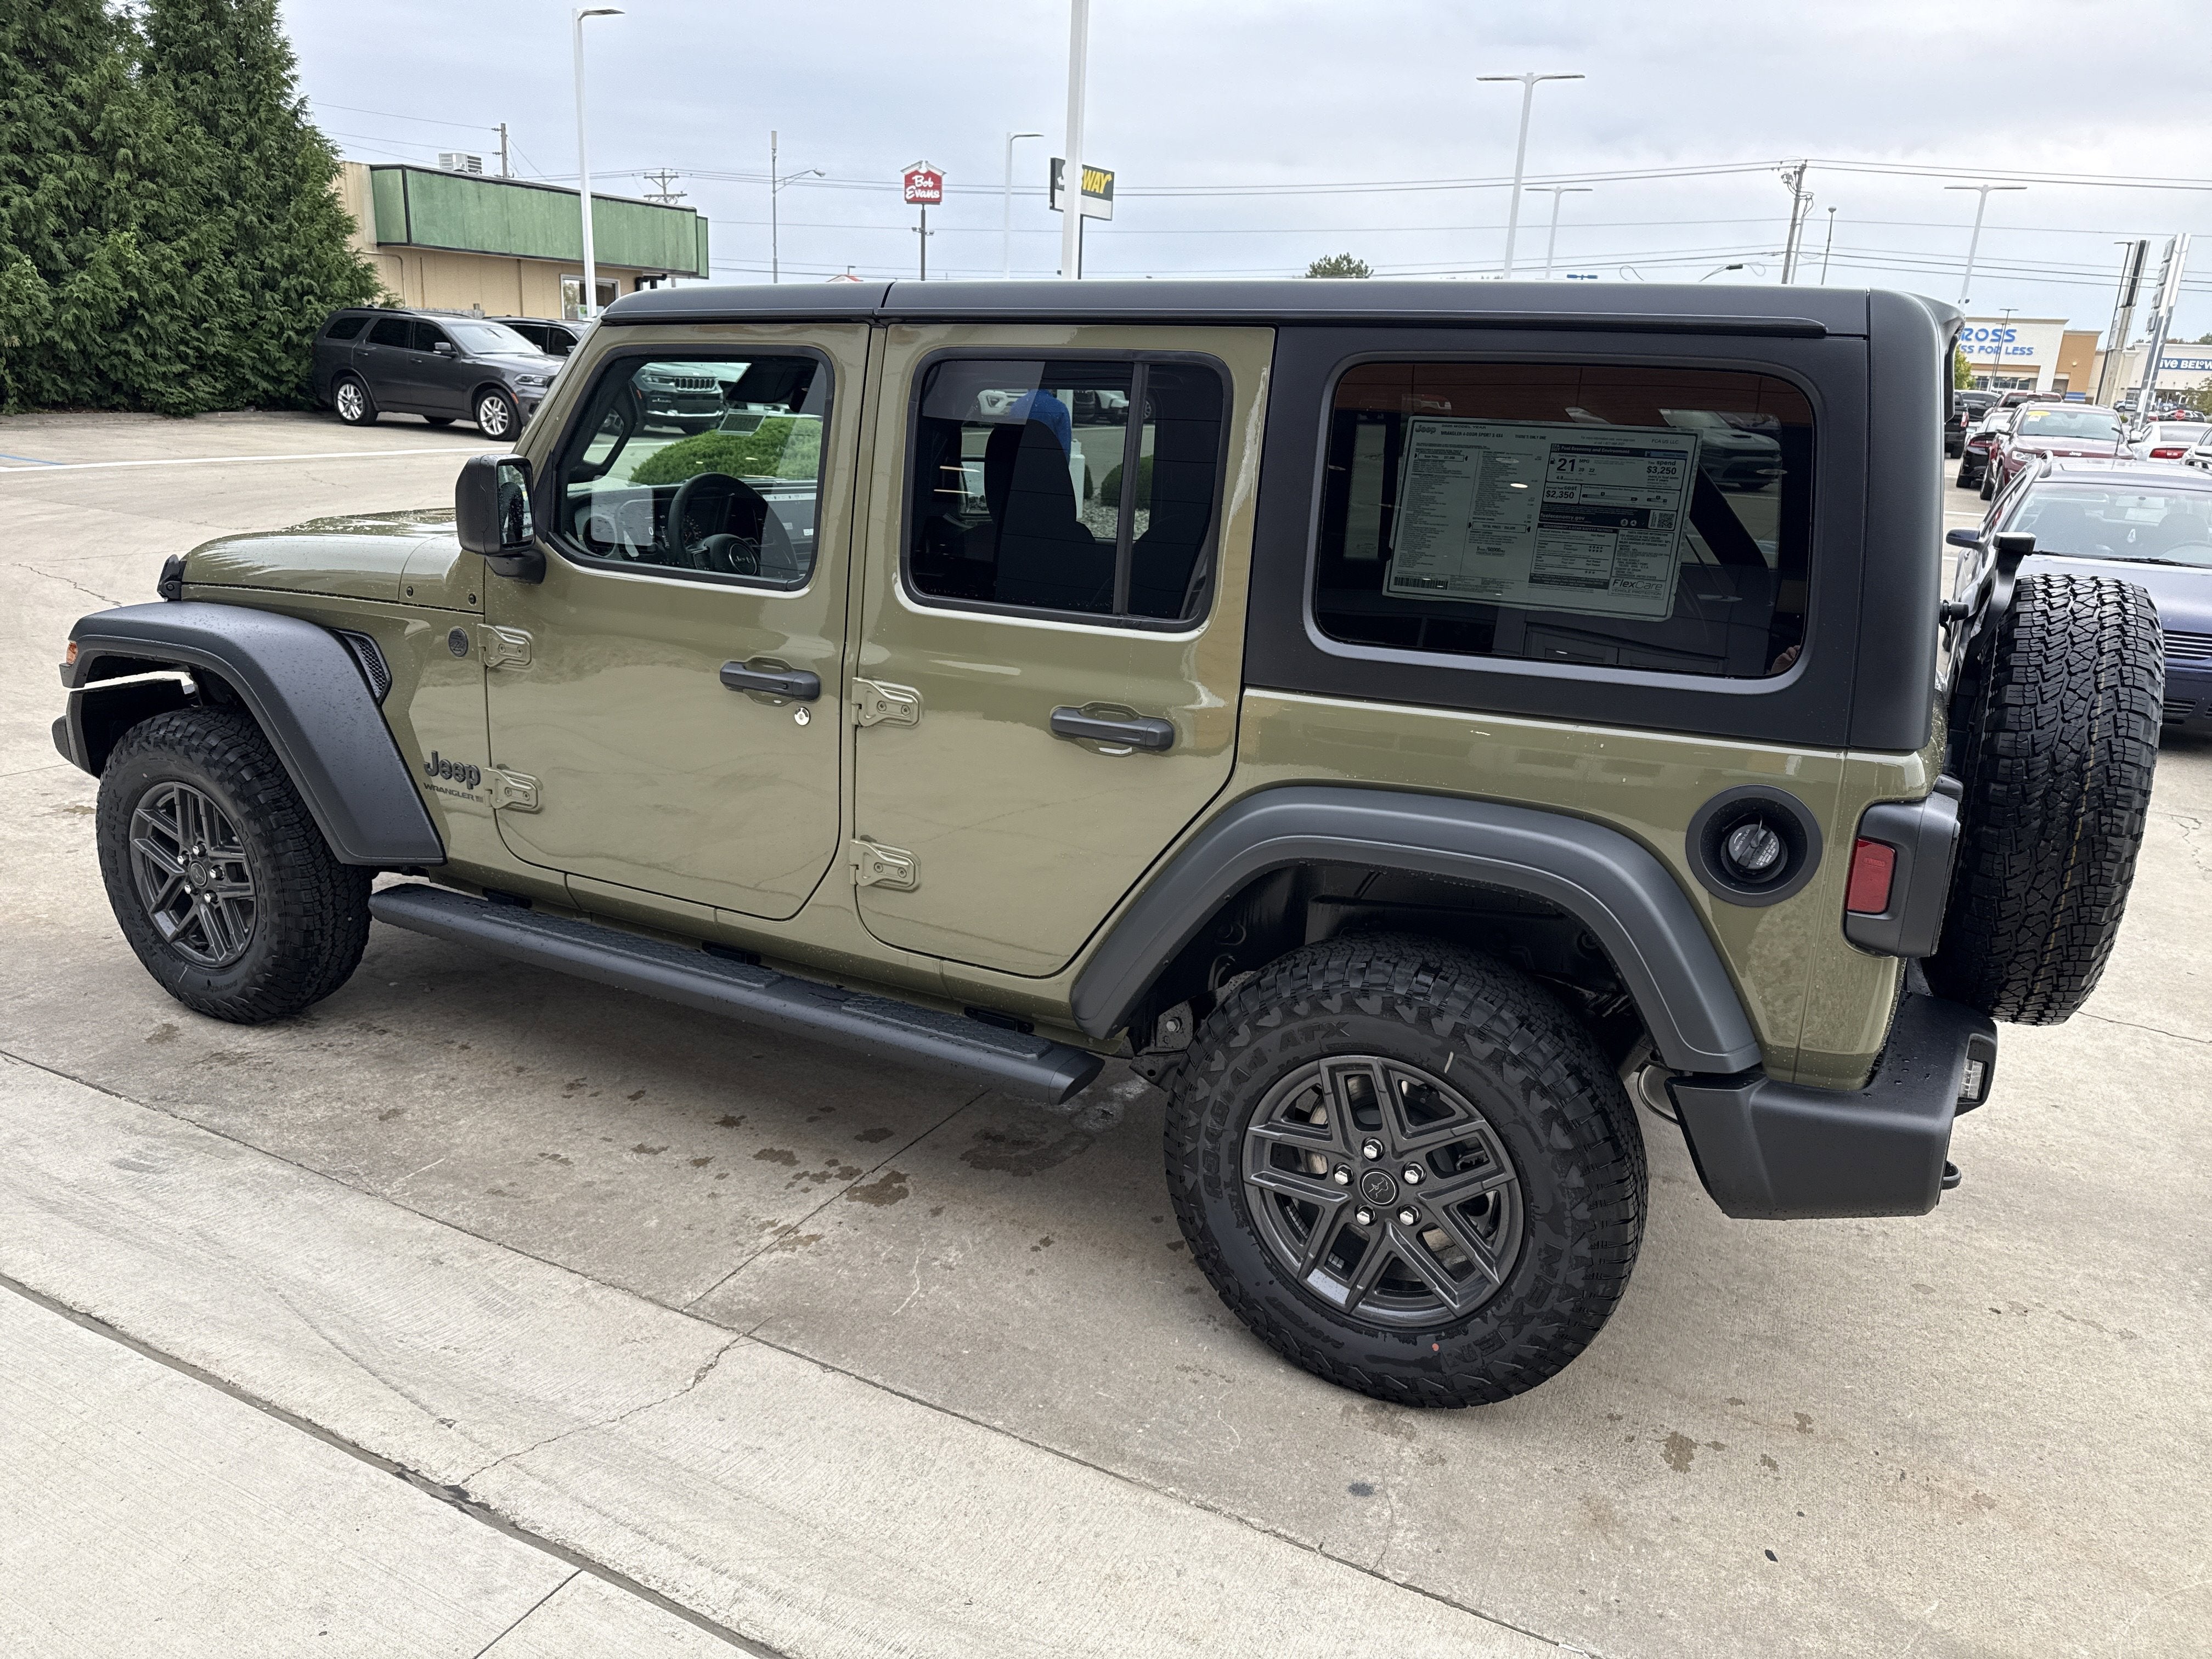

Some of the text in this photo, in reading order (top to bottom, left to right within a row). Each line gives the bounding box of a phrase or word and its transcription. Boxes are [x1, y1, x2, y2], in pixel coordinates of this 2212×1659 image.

[911, 175, 934, 188] Bob
[906, 185, 940, 199] Evans
[1961, 328, 2017, 342] ROSS
[2005, 347, 2034, 355] LESS
[2159, 359, 2179, 368] ive
[1415, 425, 1436, 434] Jeep
[1556, 458, 1576, 472] 21
[1646, 466, 1677, 475] $3,250
[1545, 490, 1574, 499] $2,350
[1612, 579, 1663, 590] FlexCare
[424, 751, 481, 790] Jeep
[424, 782, 475, 801] WRANGLER
[1279, 1021, 1350, 1052] ATX
[1441, 1241, 1562, 1368] NEXEN
